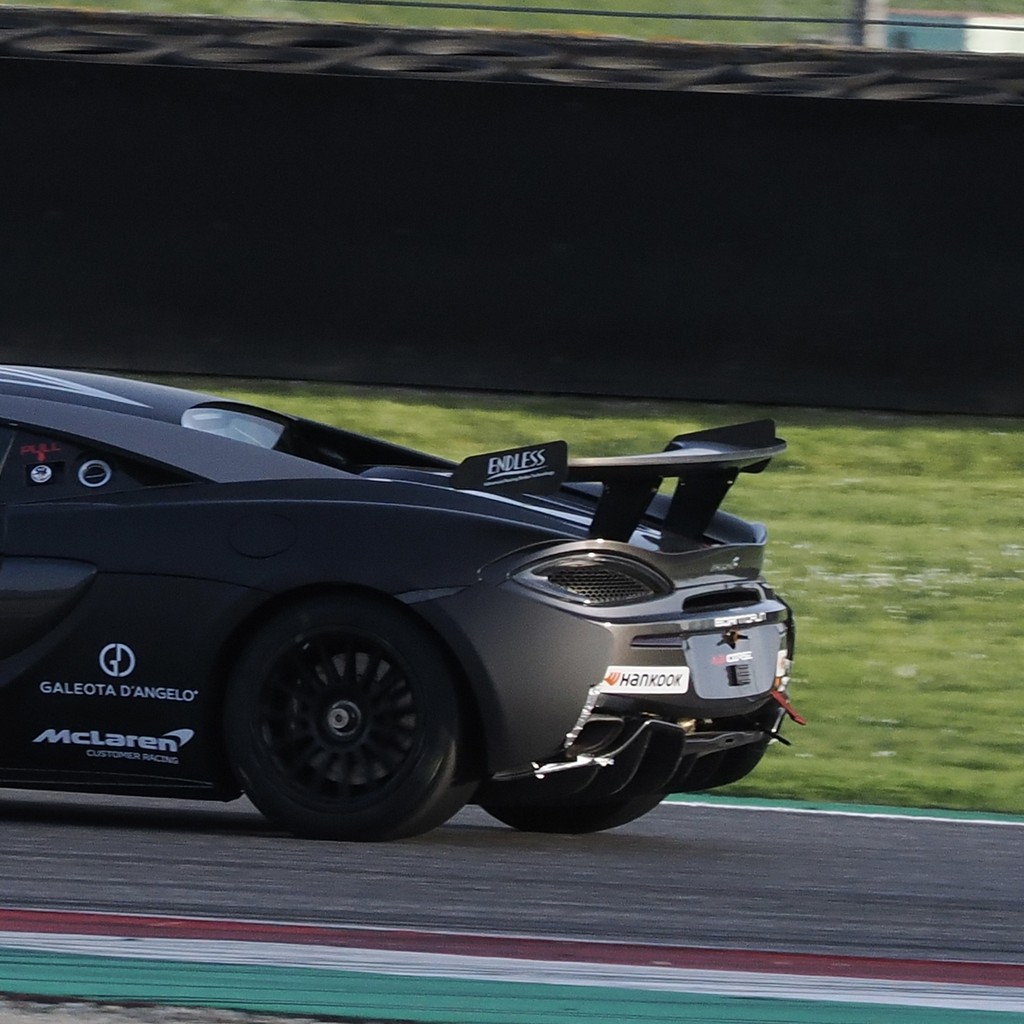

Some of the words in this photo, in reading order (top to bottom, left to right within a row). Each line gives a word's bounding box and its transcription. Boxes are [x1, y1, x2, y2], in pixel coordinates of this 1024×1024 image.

[487, 449, 546, 475] ENDLESS
[39, 681, 117, 697] GALEOTA
[32, 729, 178, 752] McLaren
[85, 749, 141, 761] CUSTOMER
[142, 753, 180, 765] RACING
